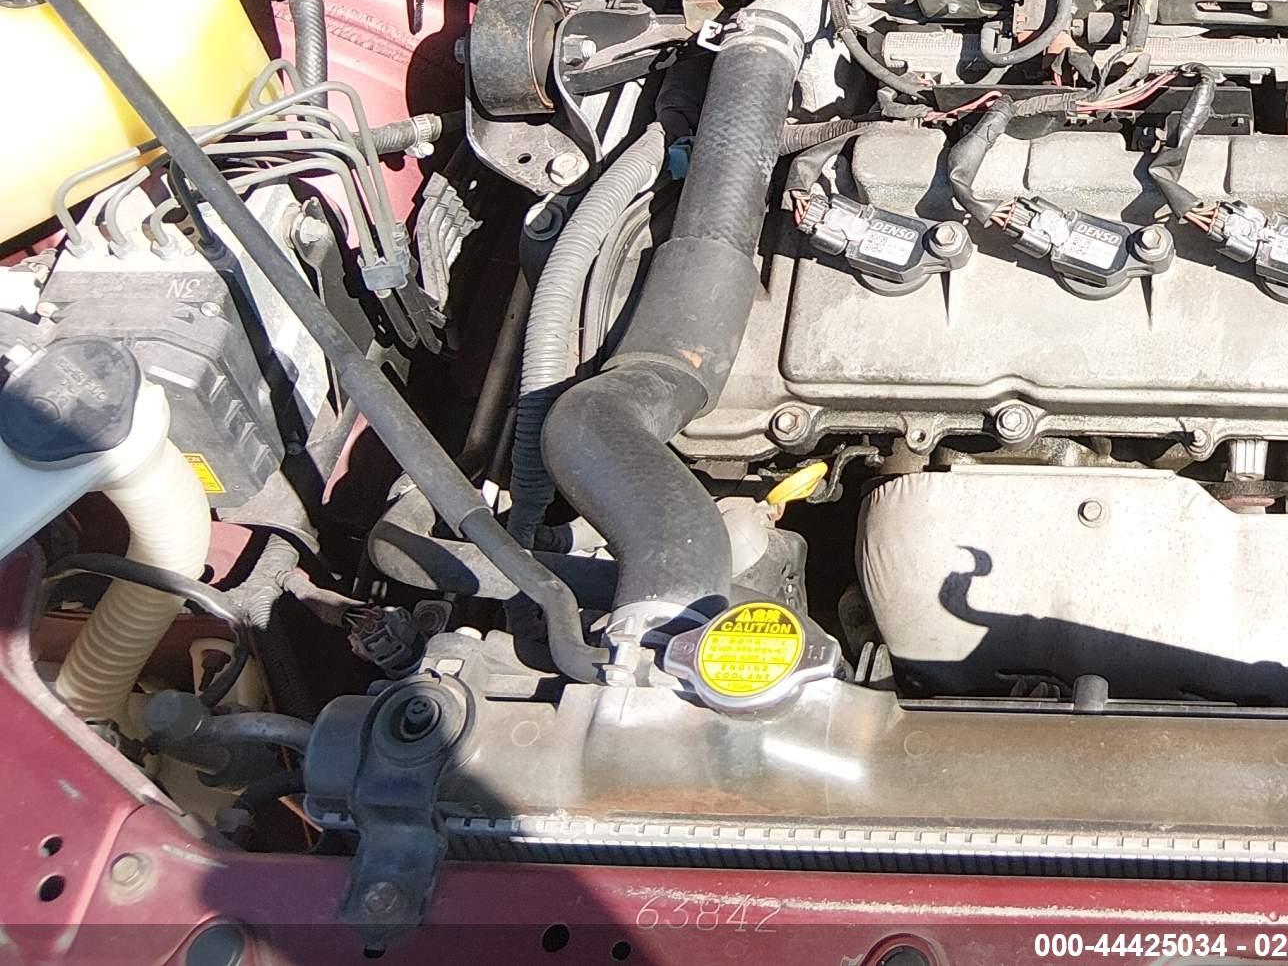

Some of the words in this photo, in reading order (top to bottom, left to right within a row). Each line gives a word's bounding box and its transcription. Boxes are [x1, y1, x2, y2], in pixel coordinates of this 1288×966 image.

[870, 220, 916, 241] DENSO
[1076, 224, 1119, 244] DENSO
[720, 621, 791, 634] CAUTION
[714, 672, 770, 680] COOLANT
[721, 664, 769, 672] ENGINE
[635, 894, 782, 933] 63842
